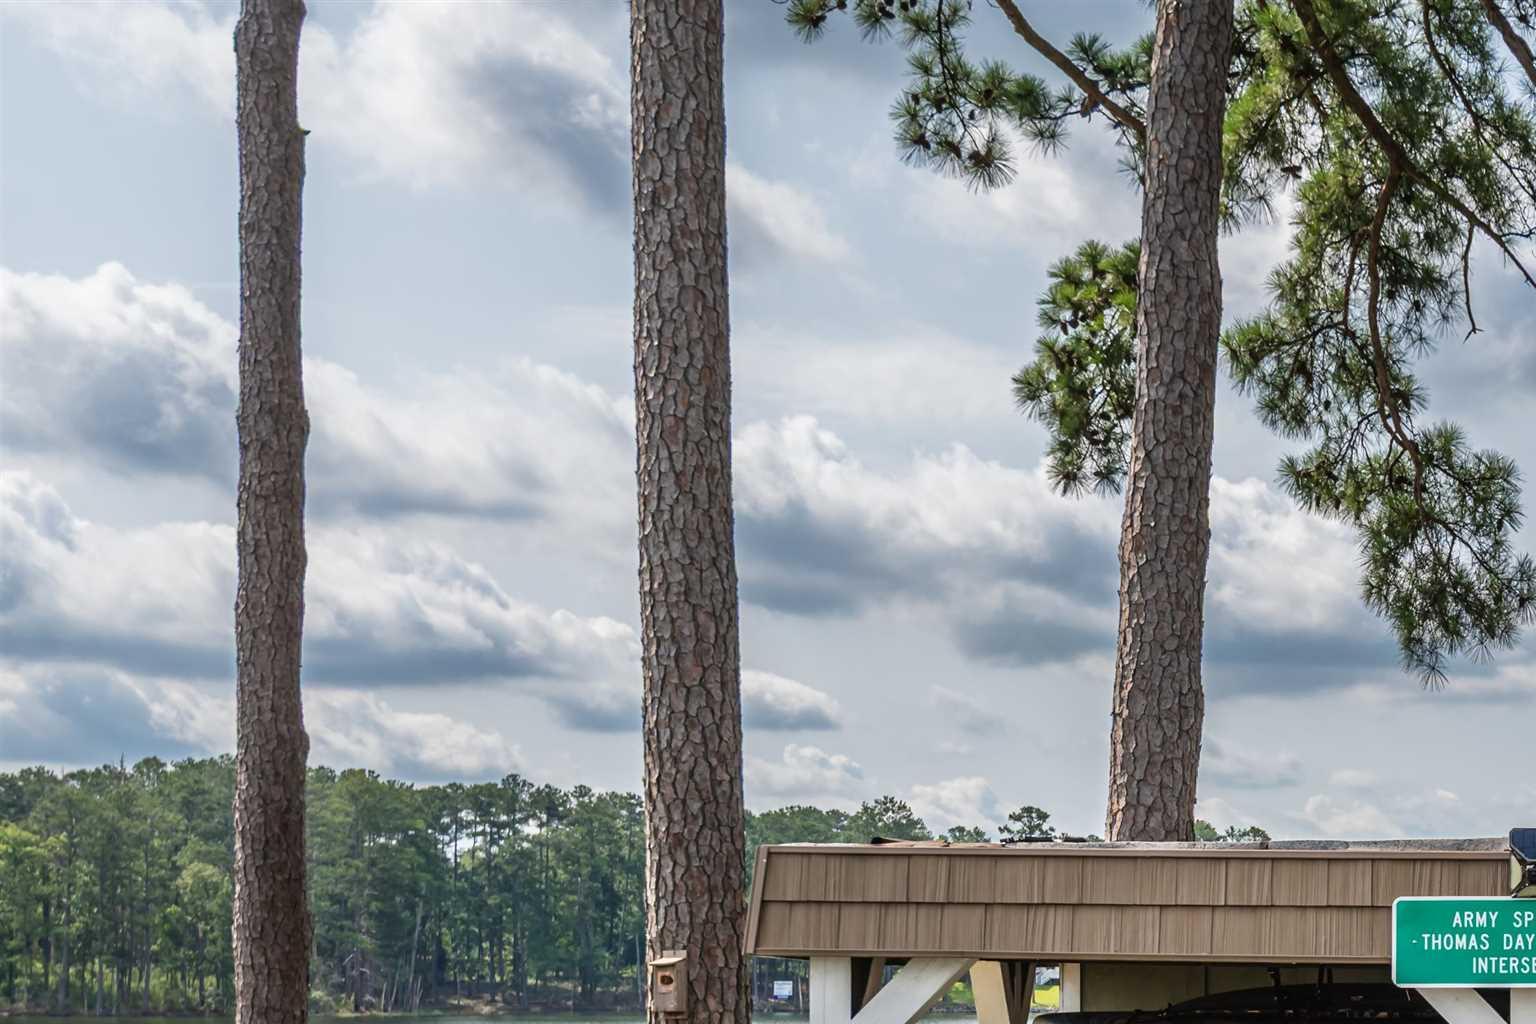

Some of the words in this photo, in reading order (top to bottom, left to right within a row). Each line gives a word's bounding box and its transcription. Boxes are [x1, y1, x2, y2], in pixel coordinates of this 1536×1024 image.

[1452, 911, 1499, 928] ARMY
[1422, 933, 1490, 951] THOMAS
[1503, 933, 1535, 950] DAY
